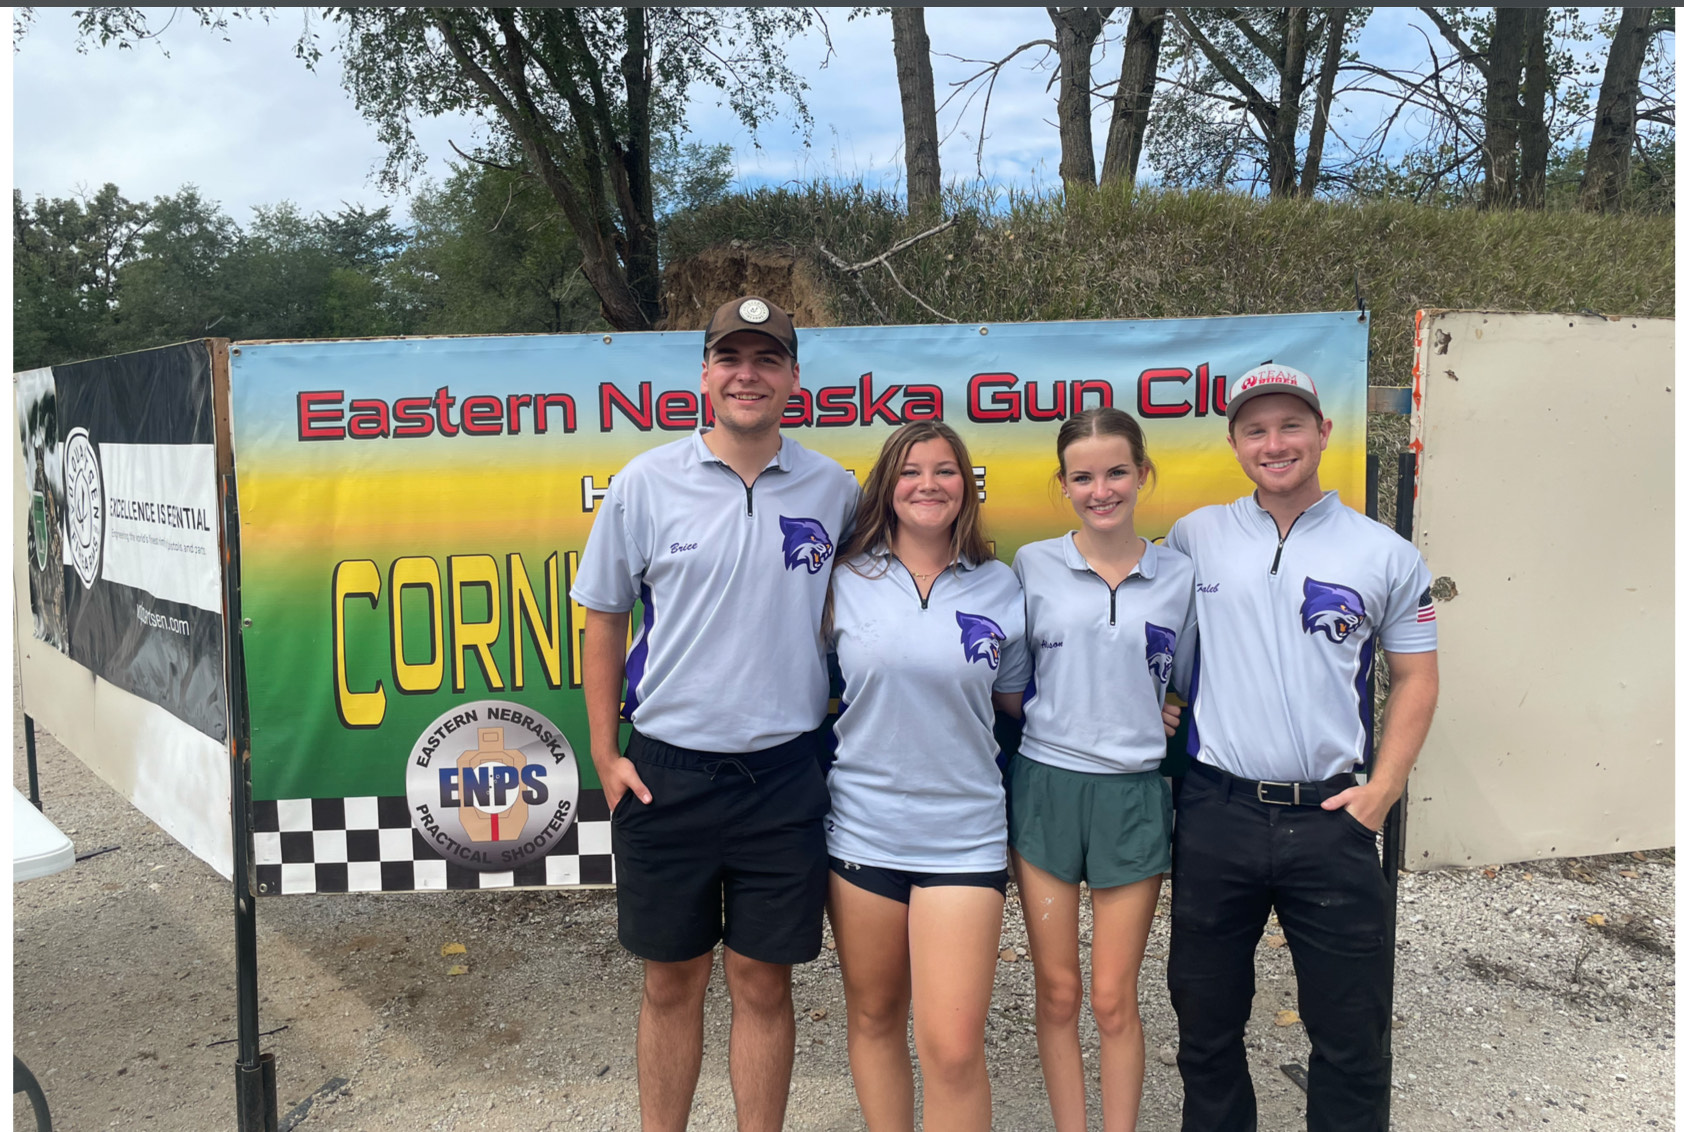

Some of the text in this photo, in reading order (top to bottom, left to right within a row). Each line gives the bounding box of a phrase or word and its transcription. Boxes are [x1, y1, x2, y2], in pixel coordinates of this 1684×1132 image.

[1258, 369, 1297, 380] TEAM
[298, 360, 1272, 441] Eastern Neaska Gun Clu
[110, 497, 156, 523] EXCELLENCE
[157, 503, 166, 524] IS
[670, 542, 698, 554] Brice
[416, 708, 566, 768] EASTERN NEBRASKA
[439, 764, 549, 808] ENPS
[416, 799, 571, 864] PRACTICAL SHOOTERS
